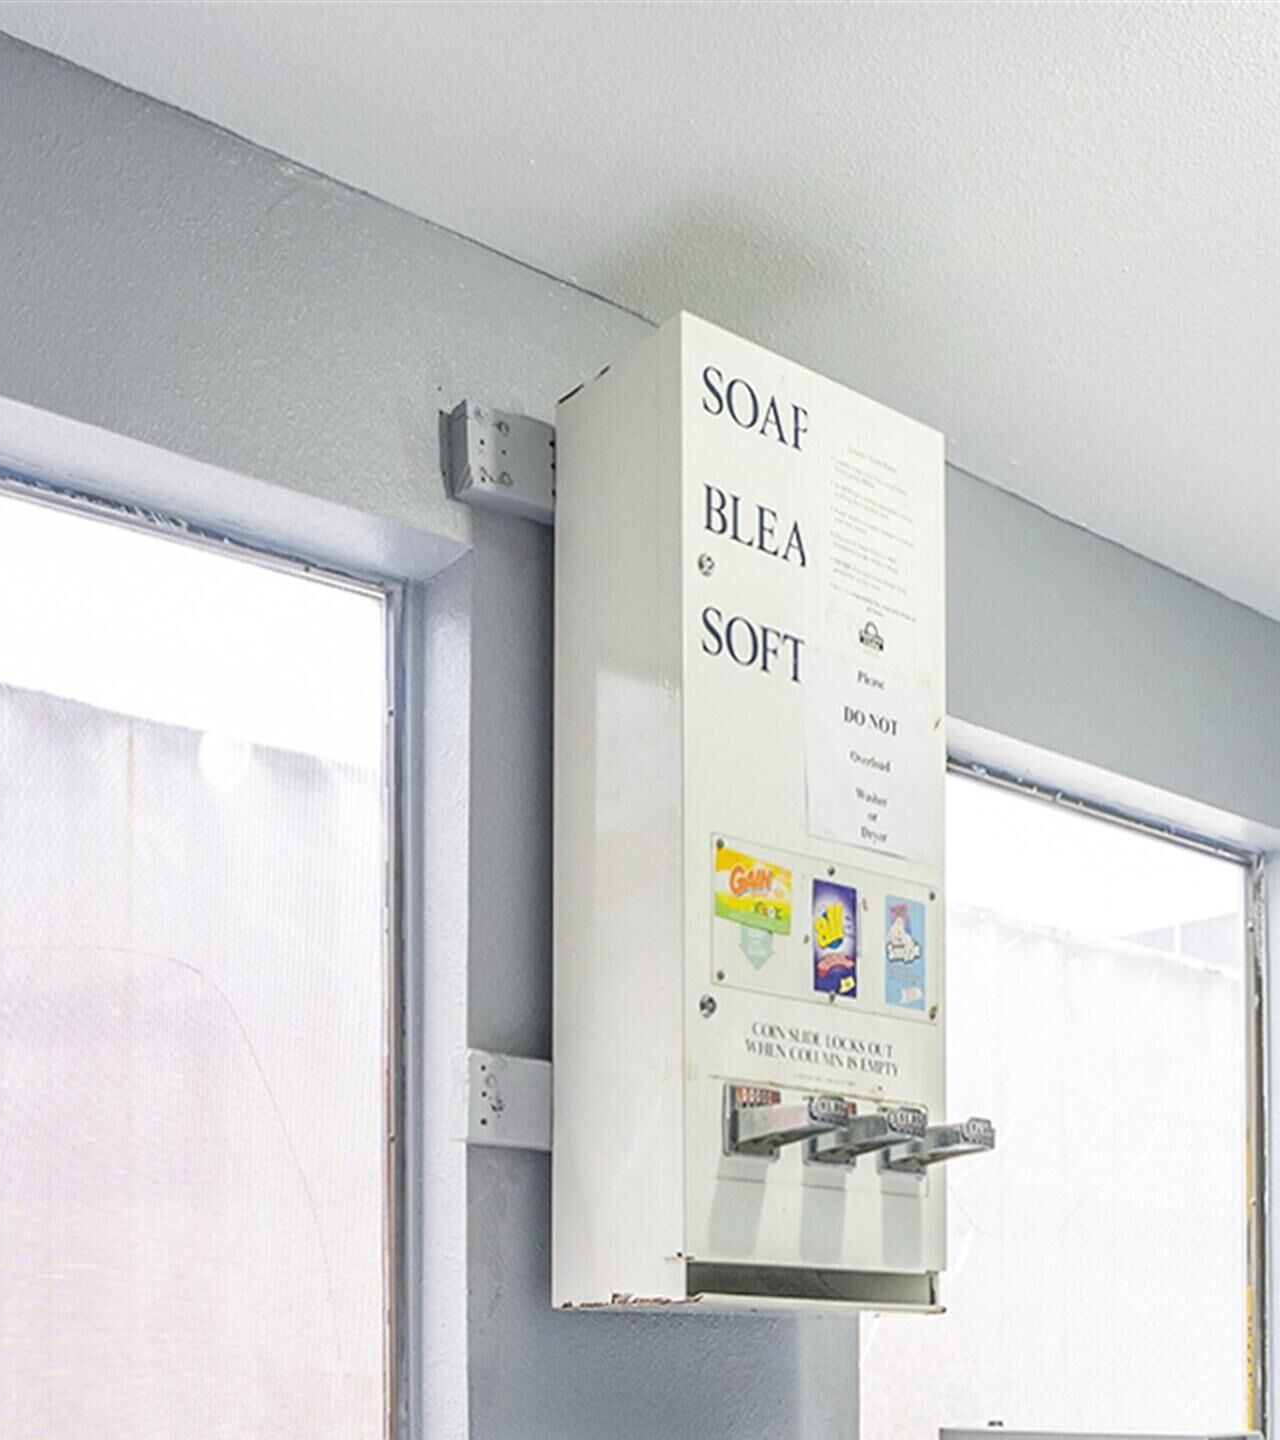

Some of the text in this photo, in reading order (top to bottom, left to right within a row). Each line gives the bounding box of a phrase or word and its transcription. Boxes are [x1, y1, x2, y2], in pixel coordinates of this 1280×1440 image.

[702, 606, 806, 685] SOFT
[843, 706, 898, 737] DO NOT
[745, 1038, 786, 1059] WHEN
[860, 1058, 898, 1077] EMPTY
[751, 1021, 785, 1039] COIN
[825, 1034, 865, 1053] LOCKS
[867, 1042, 893, 1058] OUT
